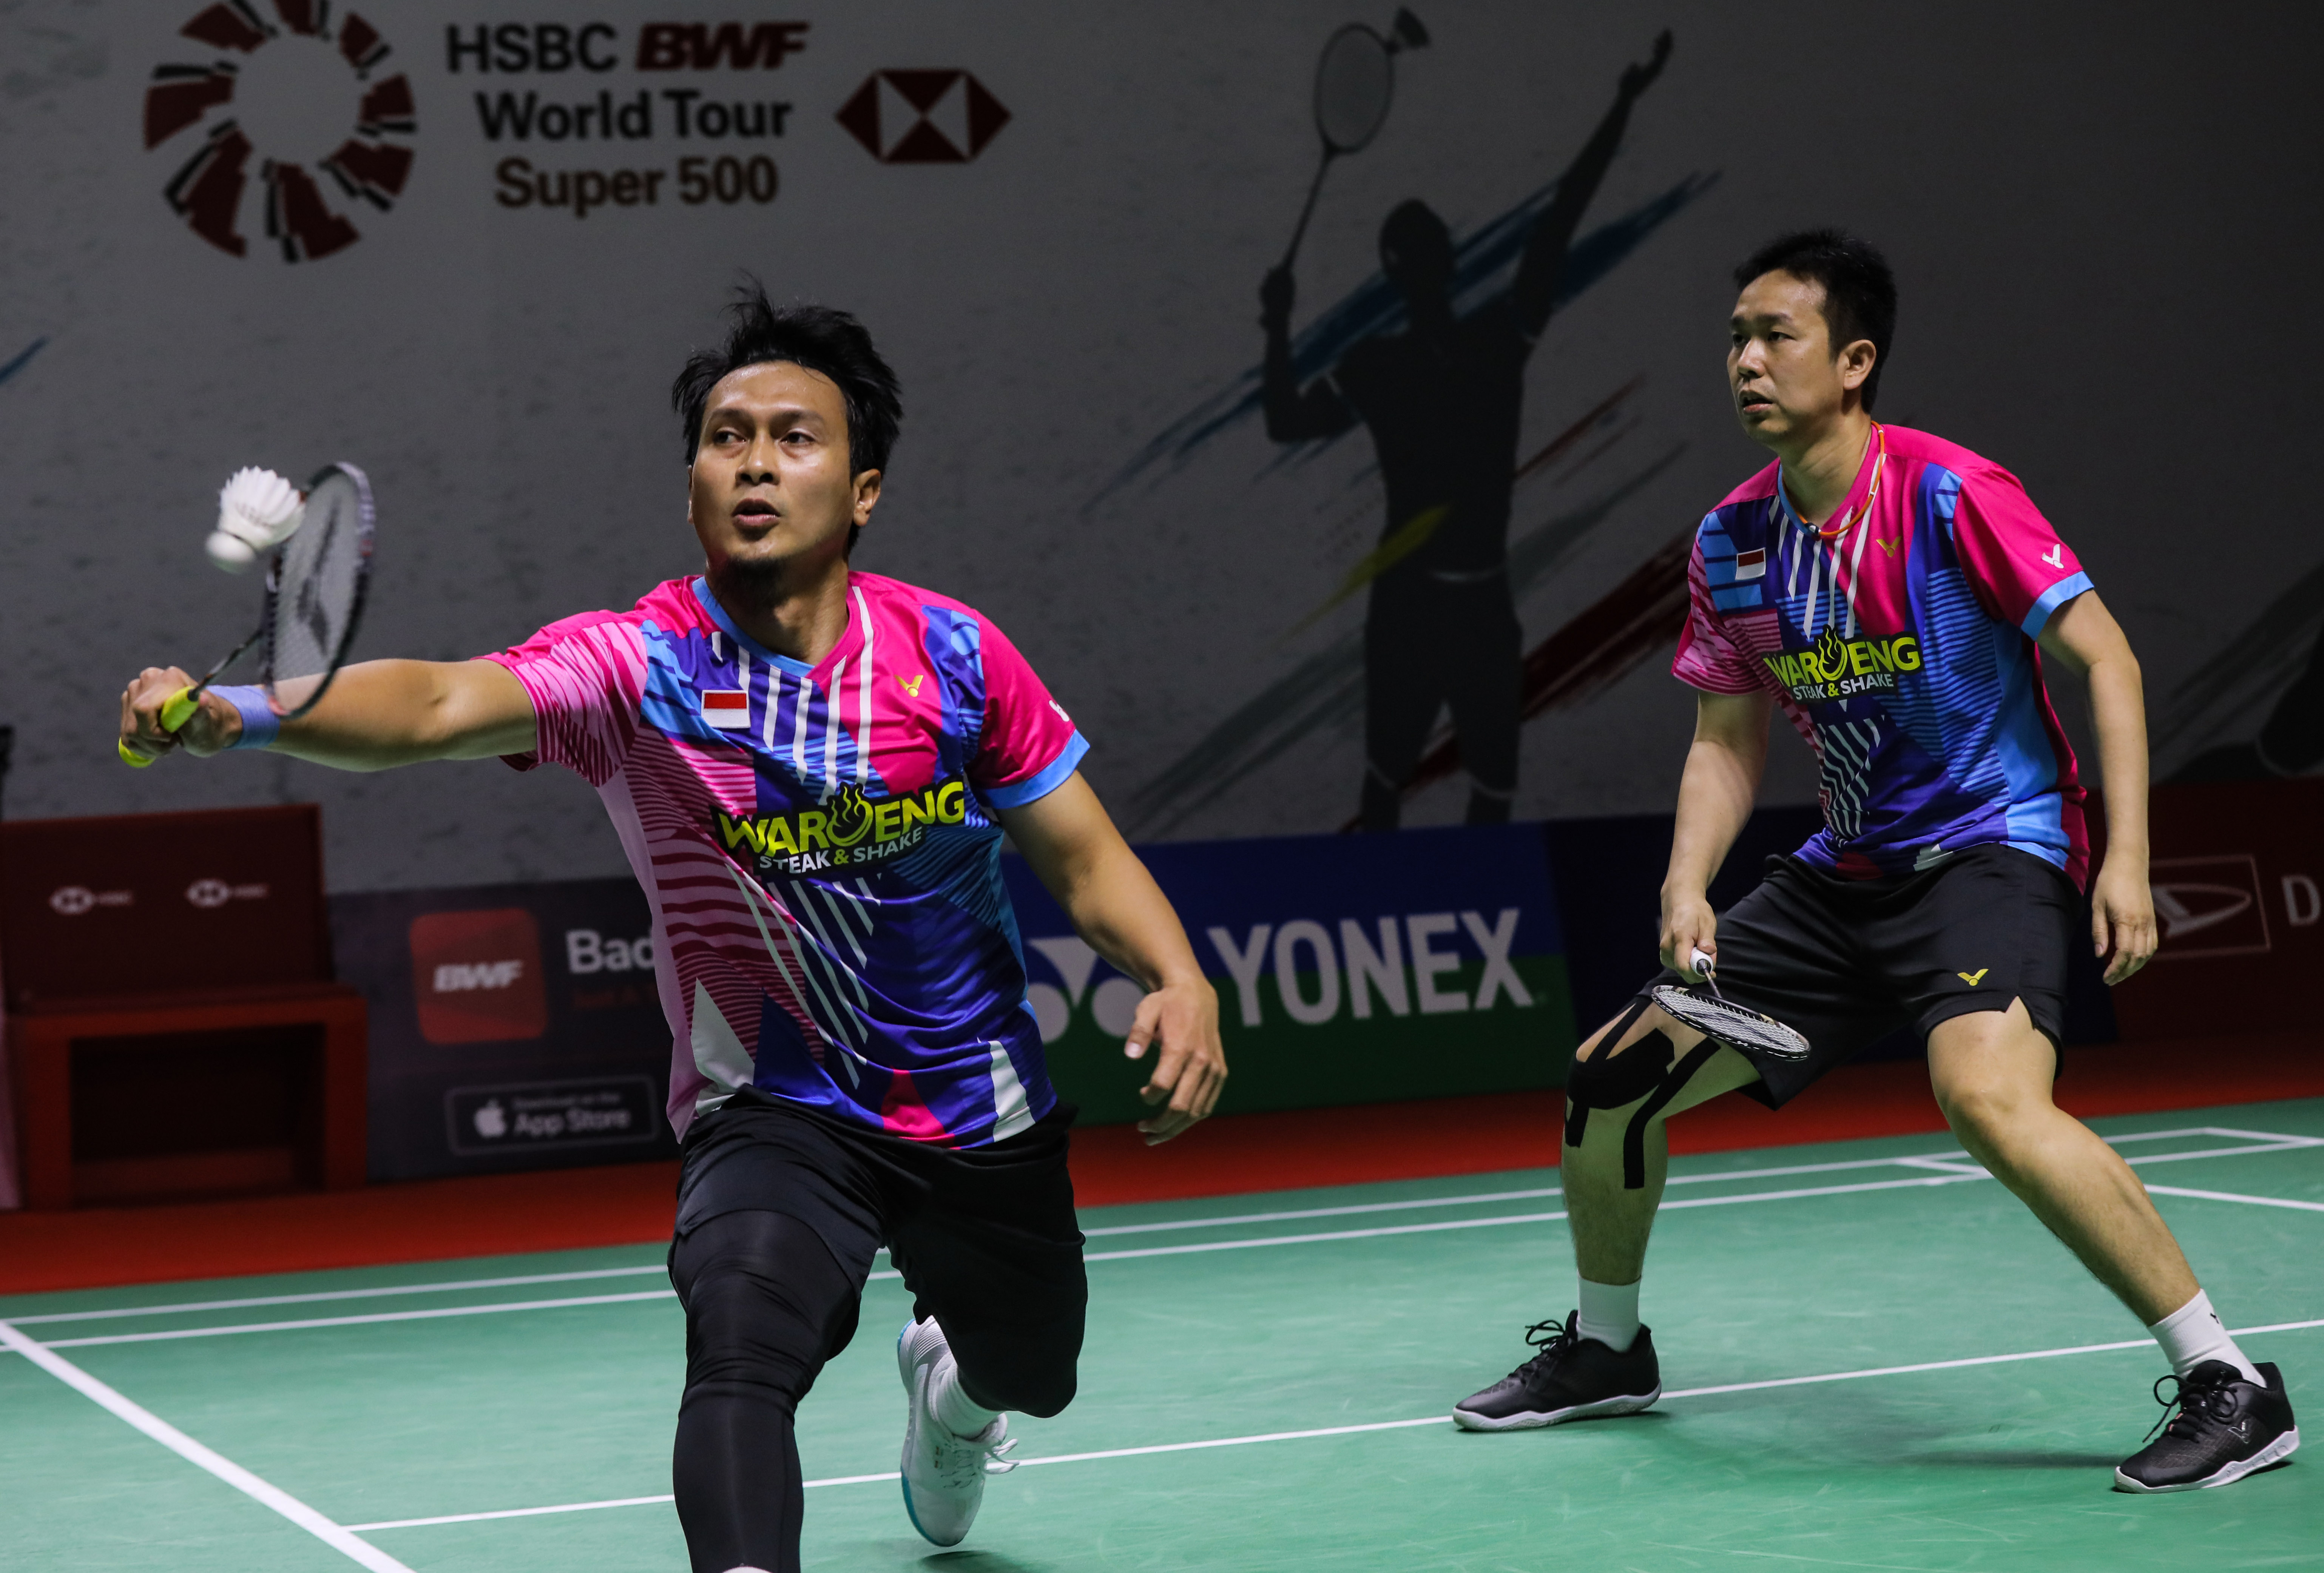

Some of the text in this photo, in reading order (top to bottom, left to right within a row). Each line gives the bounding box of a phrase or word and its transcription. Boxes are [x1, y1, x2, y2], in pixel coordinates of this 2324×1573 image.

[446, 22, 811, 72] HSBC BWF
[475, 89, 792, 140] World Tour
[496, 155, 778, 218] Super 500
[1793, 674, 1894, 700] STEAK & SHAKE
[760, 826, 923, 874] STEAK & SHAKE
[434, 960, 523, 992] BWF
[1207, 909, 1534, 1027] YONEX
